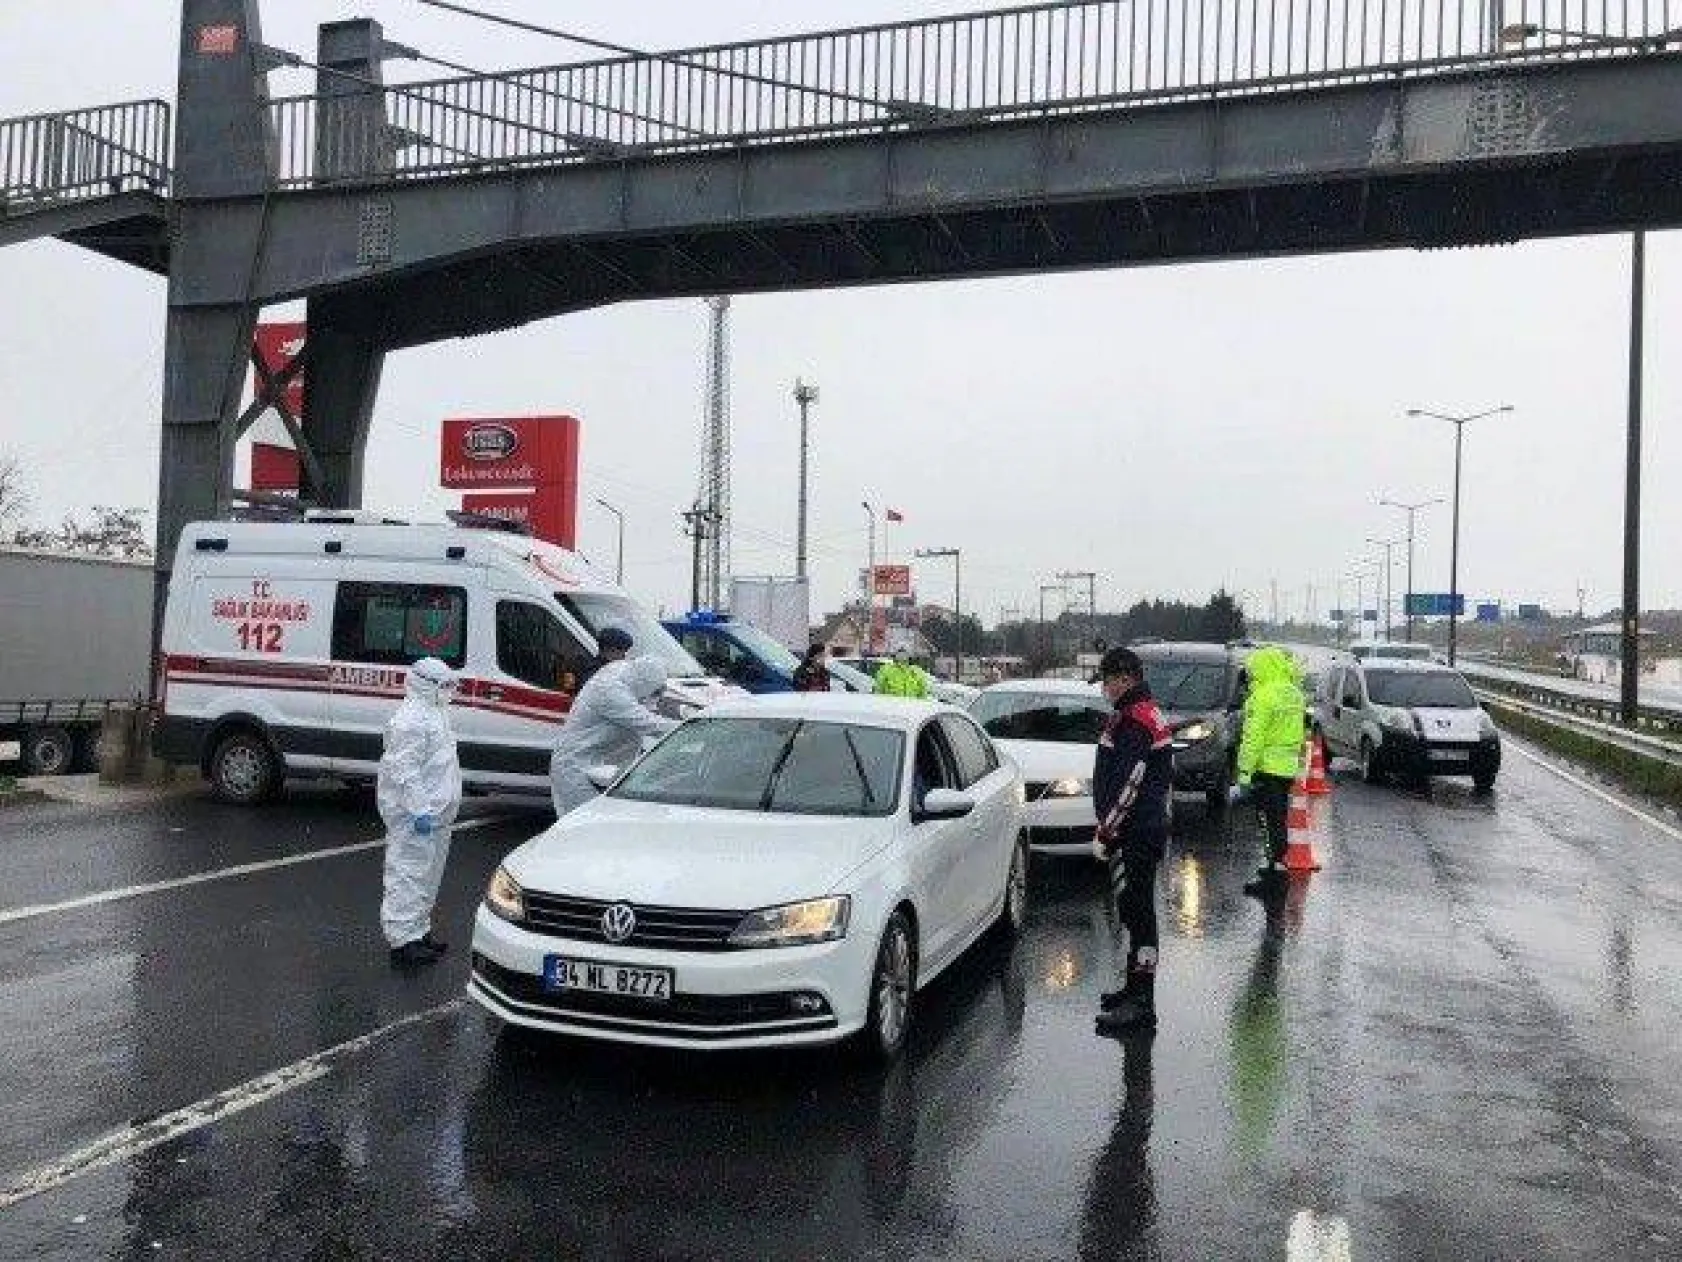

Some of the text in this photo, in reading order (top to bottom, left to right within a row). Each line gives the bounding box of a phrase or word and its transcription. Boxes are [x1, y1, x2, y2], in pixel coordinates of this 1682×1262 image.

[238, 622, 283, 653] 112
[557, 961, 579, 987] 34
[616, 968, 667, 998] 8272
